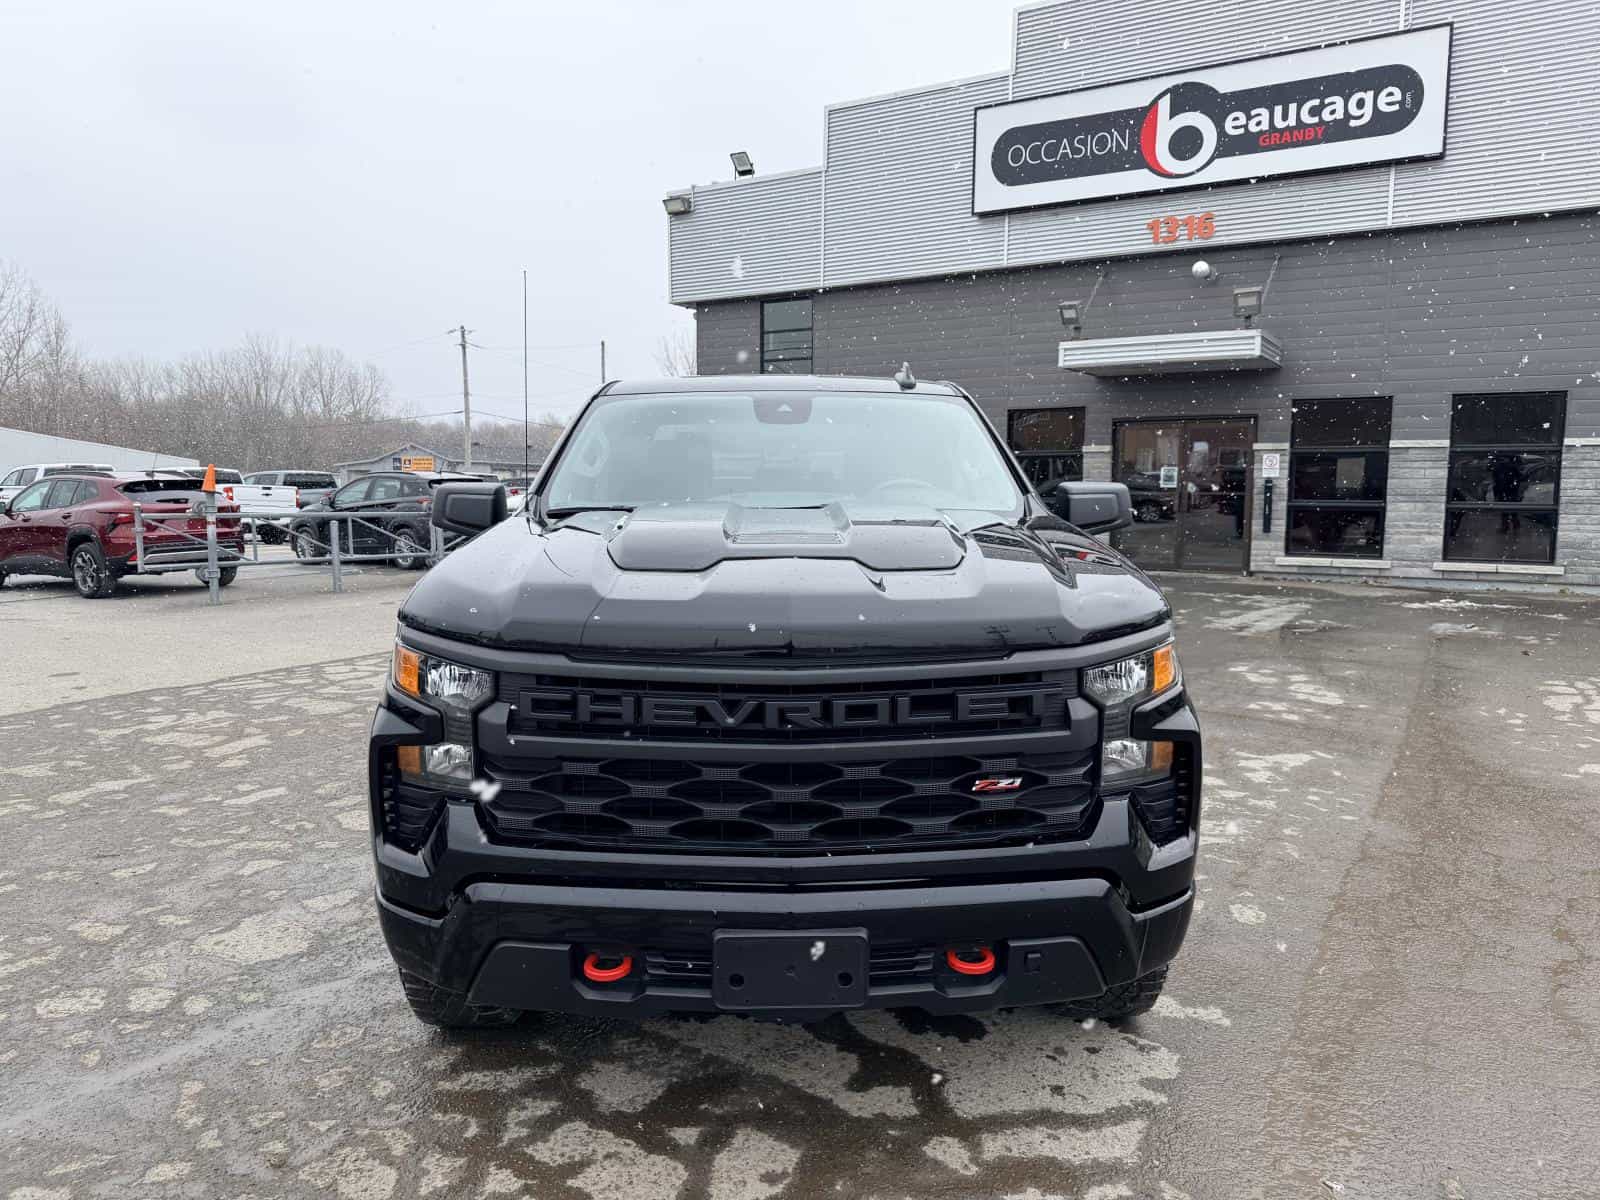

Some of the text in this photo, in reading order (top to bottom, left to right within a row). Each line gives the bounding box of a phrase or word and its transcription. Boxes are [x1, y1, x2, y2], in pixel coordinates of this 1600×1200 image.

[1008, 129, 1130, 168] OCCASION
[1259, 126, 1326, 146] GRANBY
[1147, 213, 1216, 244] 1316
[519, 686, 1063, 728] CHEVROLET
